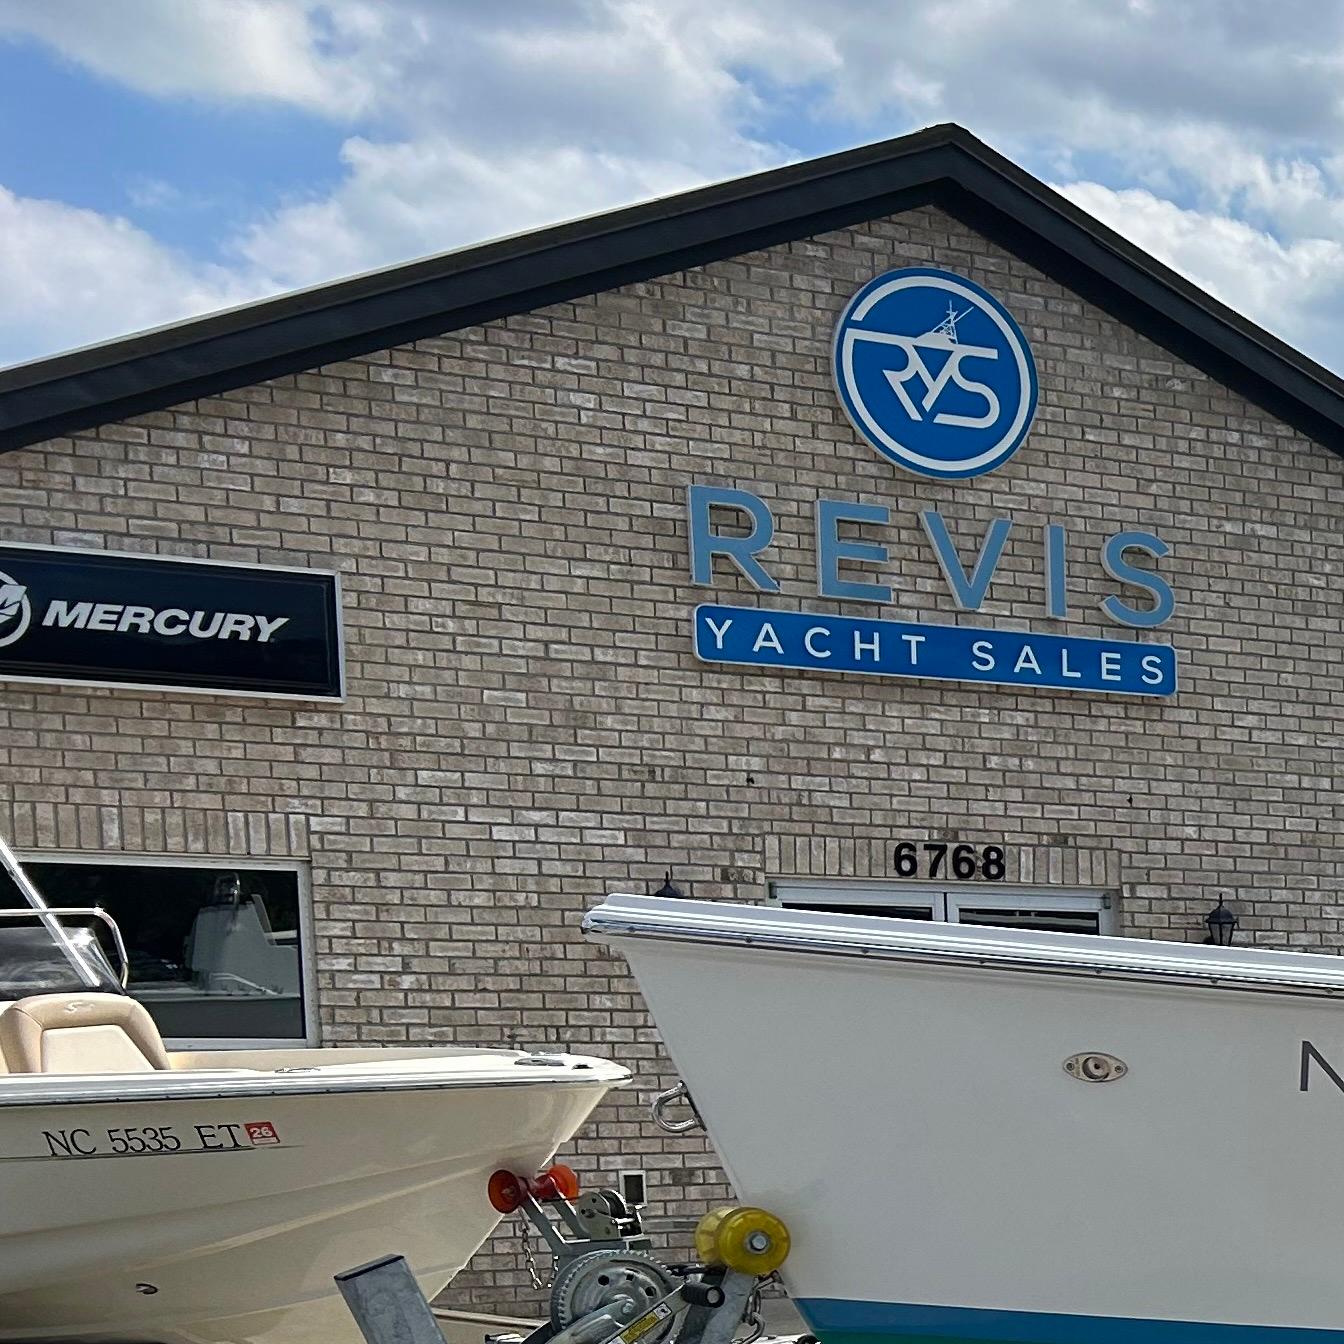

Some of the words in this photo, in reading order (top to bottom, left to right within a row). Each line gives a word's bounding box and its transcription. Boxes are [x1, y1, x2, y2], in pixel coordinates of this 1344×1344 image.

[687, 484, 1176, 629] REVIS
[42, 600, 290, 643] MERCURY
[704, 618, 927, 666] YACHT
[971, 640, 1164, 686] SALES
[893, 842, 1007, 881] 6768
[42, 1128, 97, 1157] NC
[106, 1126, 181, 1154] 5535
[193, 1123, 244, 1149] ET
[251, 1126, 273, 1138] 26
